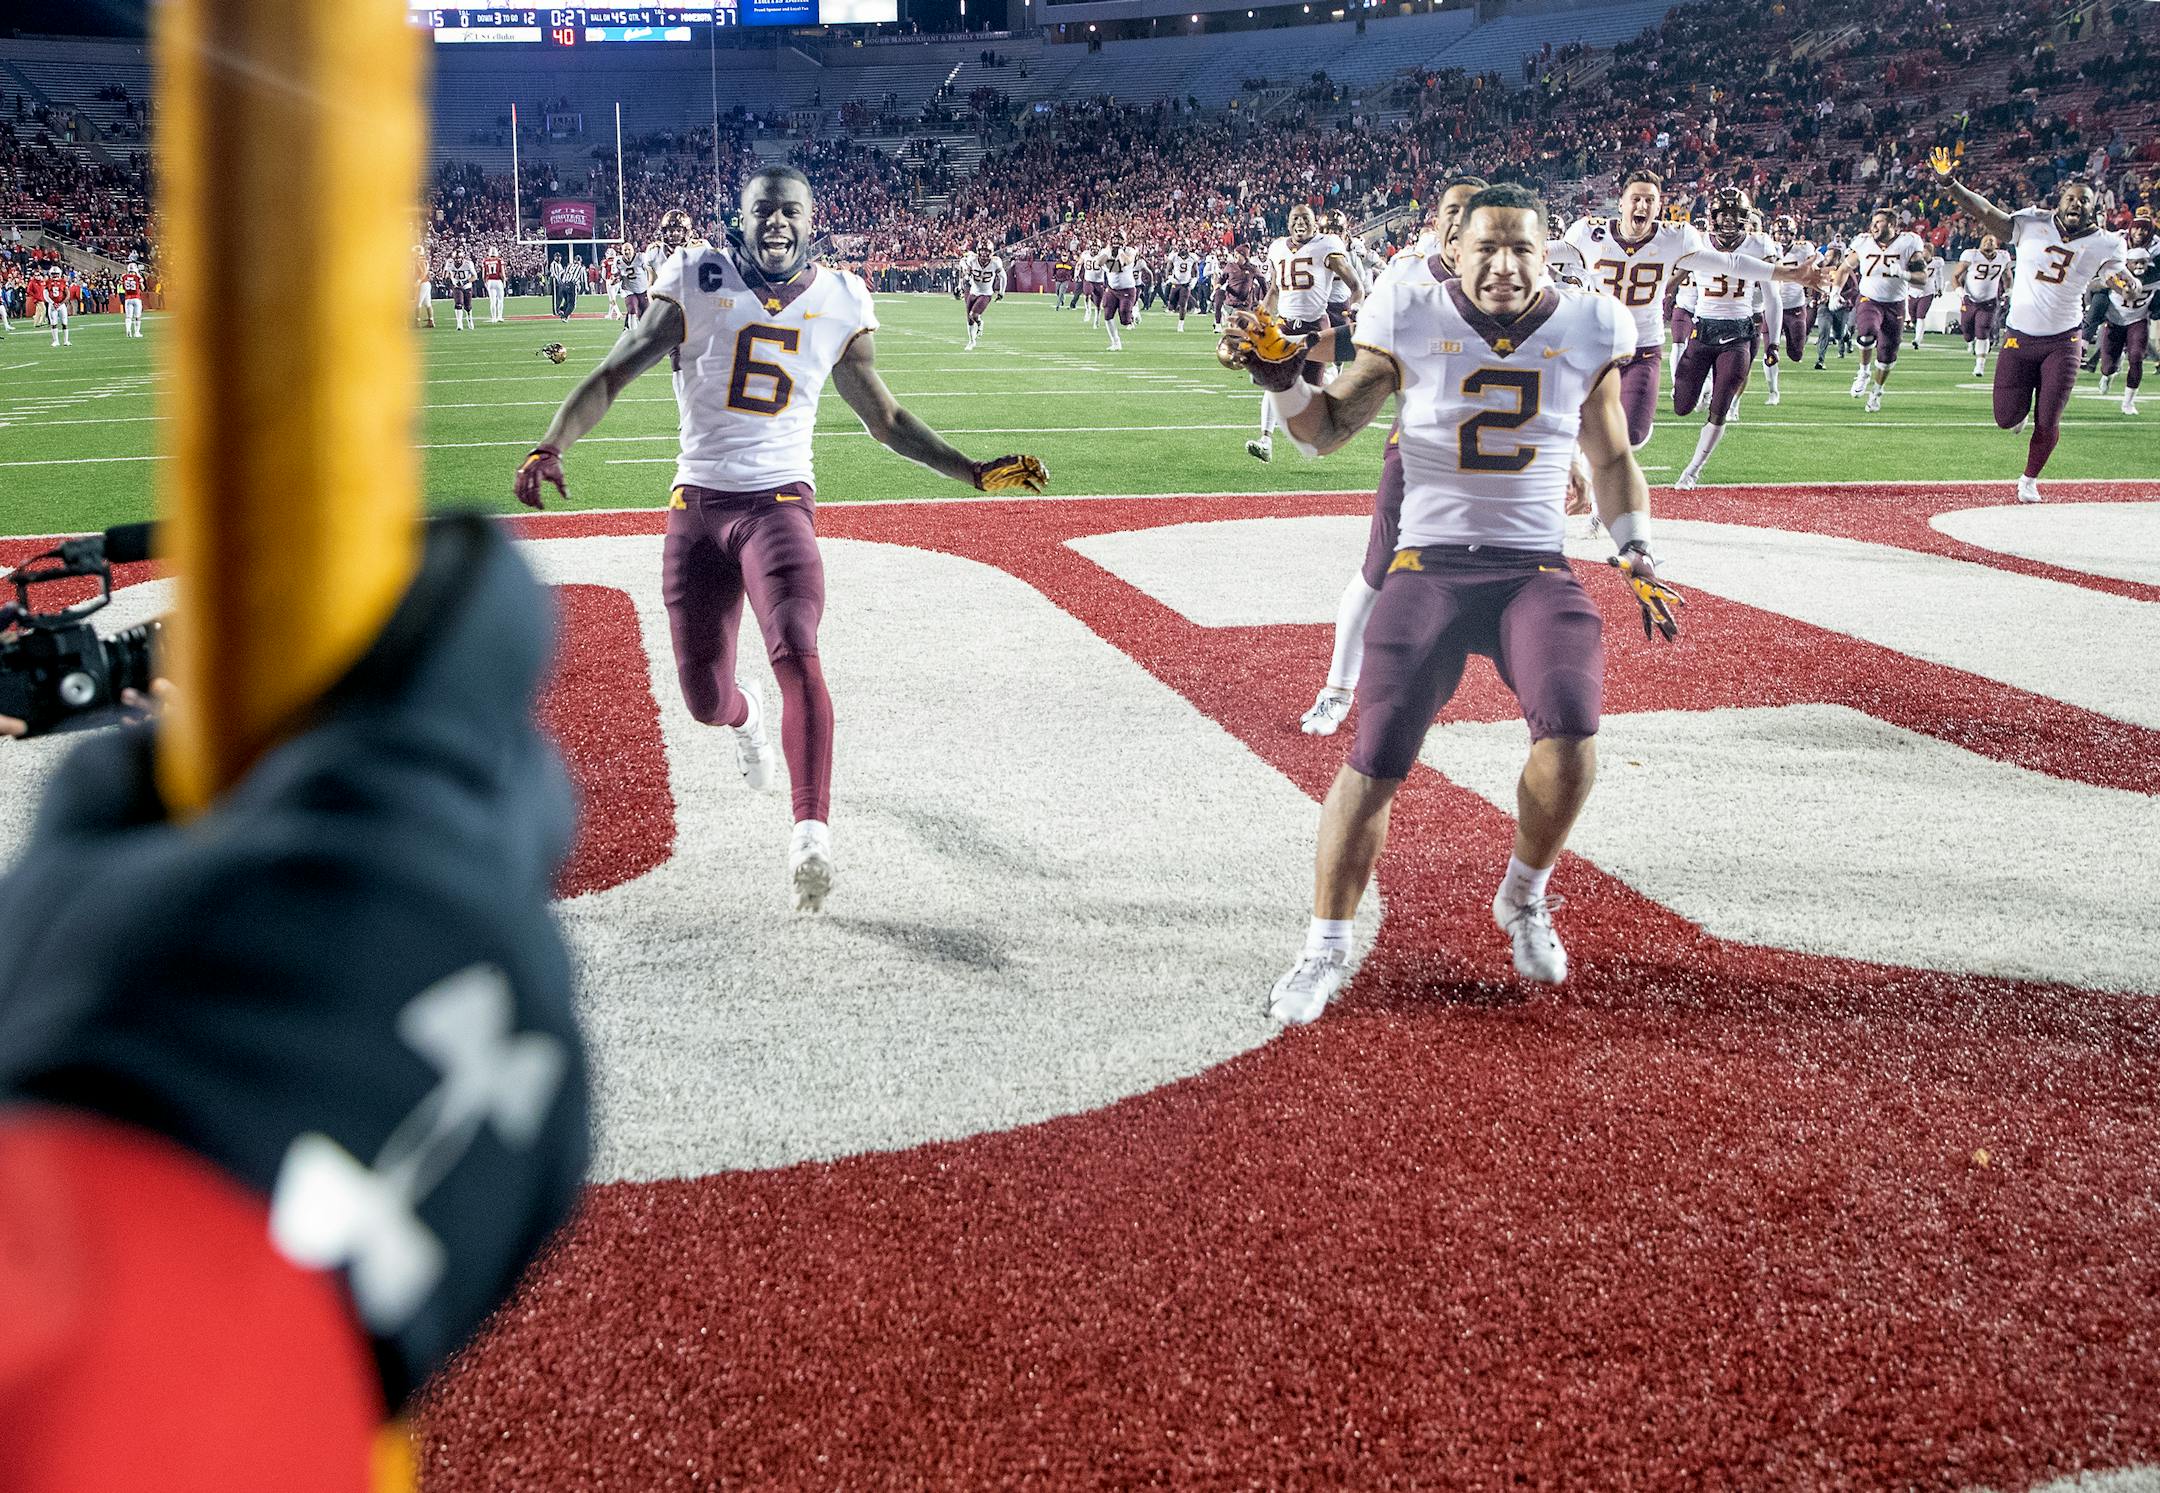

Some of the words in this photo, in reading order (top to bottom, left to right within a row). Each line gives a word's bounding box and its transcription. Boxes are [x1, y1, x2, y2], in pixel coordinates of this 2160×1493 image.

[428, 10, 444, 27] 15
[494, 12, 501, 25] 3
[502, 14, 510, 22] TO
[523, 12, 535, 24] 12
[551, 9, 586, 26] 0:27
[611, 11, 627, 24] 45
[641, 12, 650, 23] 4
[715, 9, 736, 25] 37
[553, 28, 574, 45] 40
[1277, 256, 1316, 291] 16
[1973, 263, 2002, 281] 97
[2034, 244, 2076, 285] 3
[698, 262, 723, 293] C
[1593, 258, 1665, 306] 38
[726, 322, 801, 417] 6
[1456, 365, 1542, 475] 2
